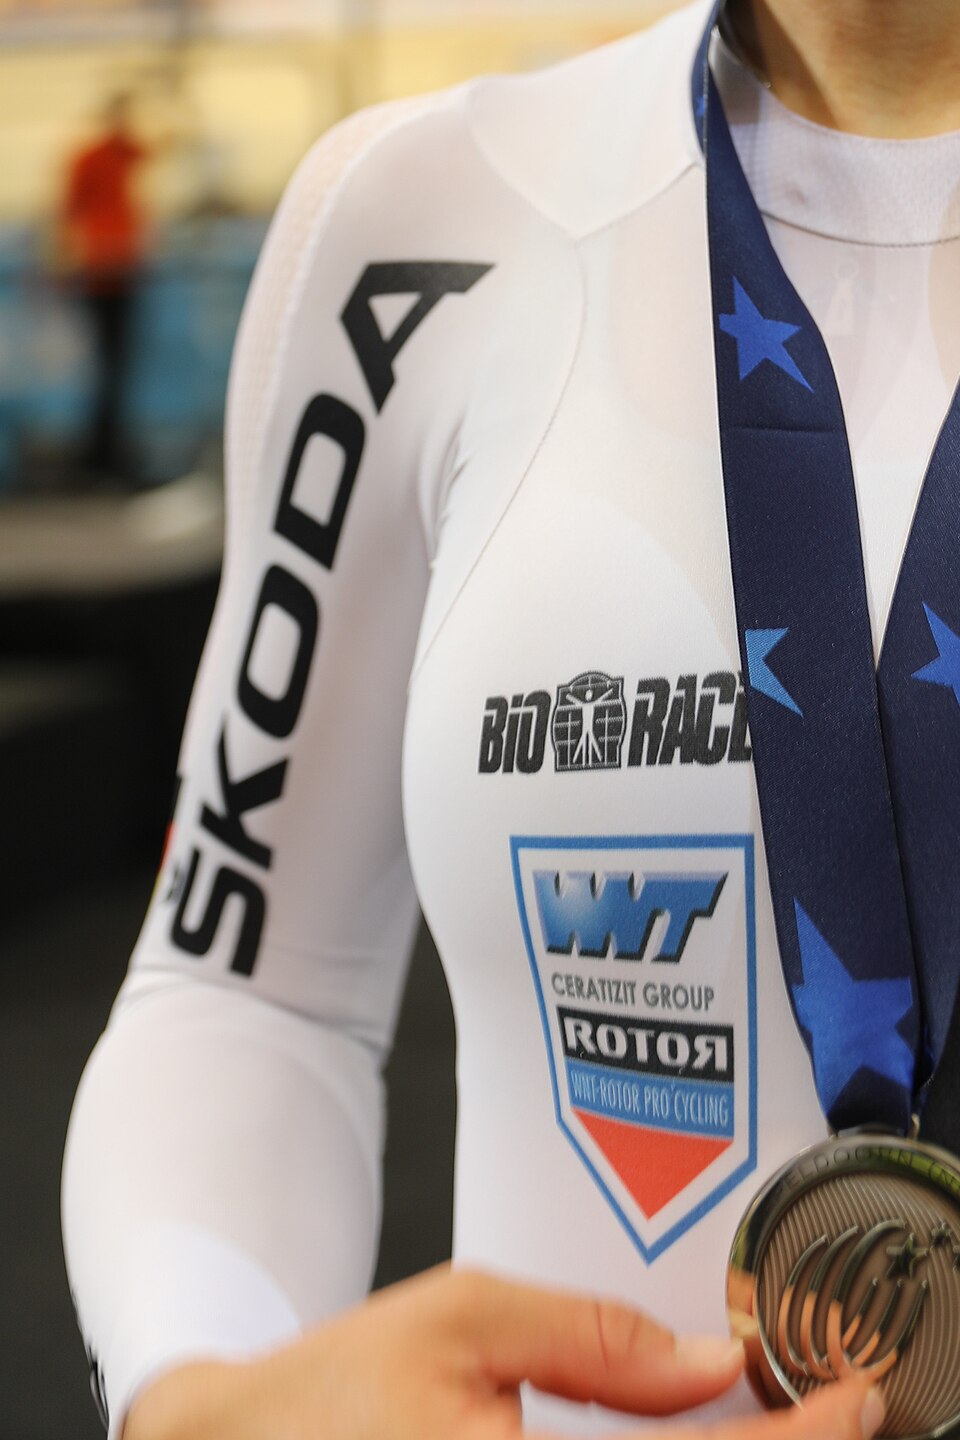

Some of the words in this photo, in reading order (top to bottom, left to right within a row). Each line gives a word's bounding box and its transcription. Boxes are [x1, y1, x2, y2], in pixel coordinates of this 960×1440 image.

[551, 971, 637, 1006] CERATIZIT
[642, 982, 715, 1011] GROUP
[643, 1084, 669, 1120] PRO
[673, 1089, 729, 1129] CYCLING
